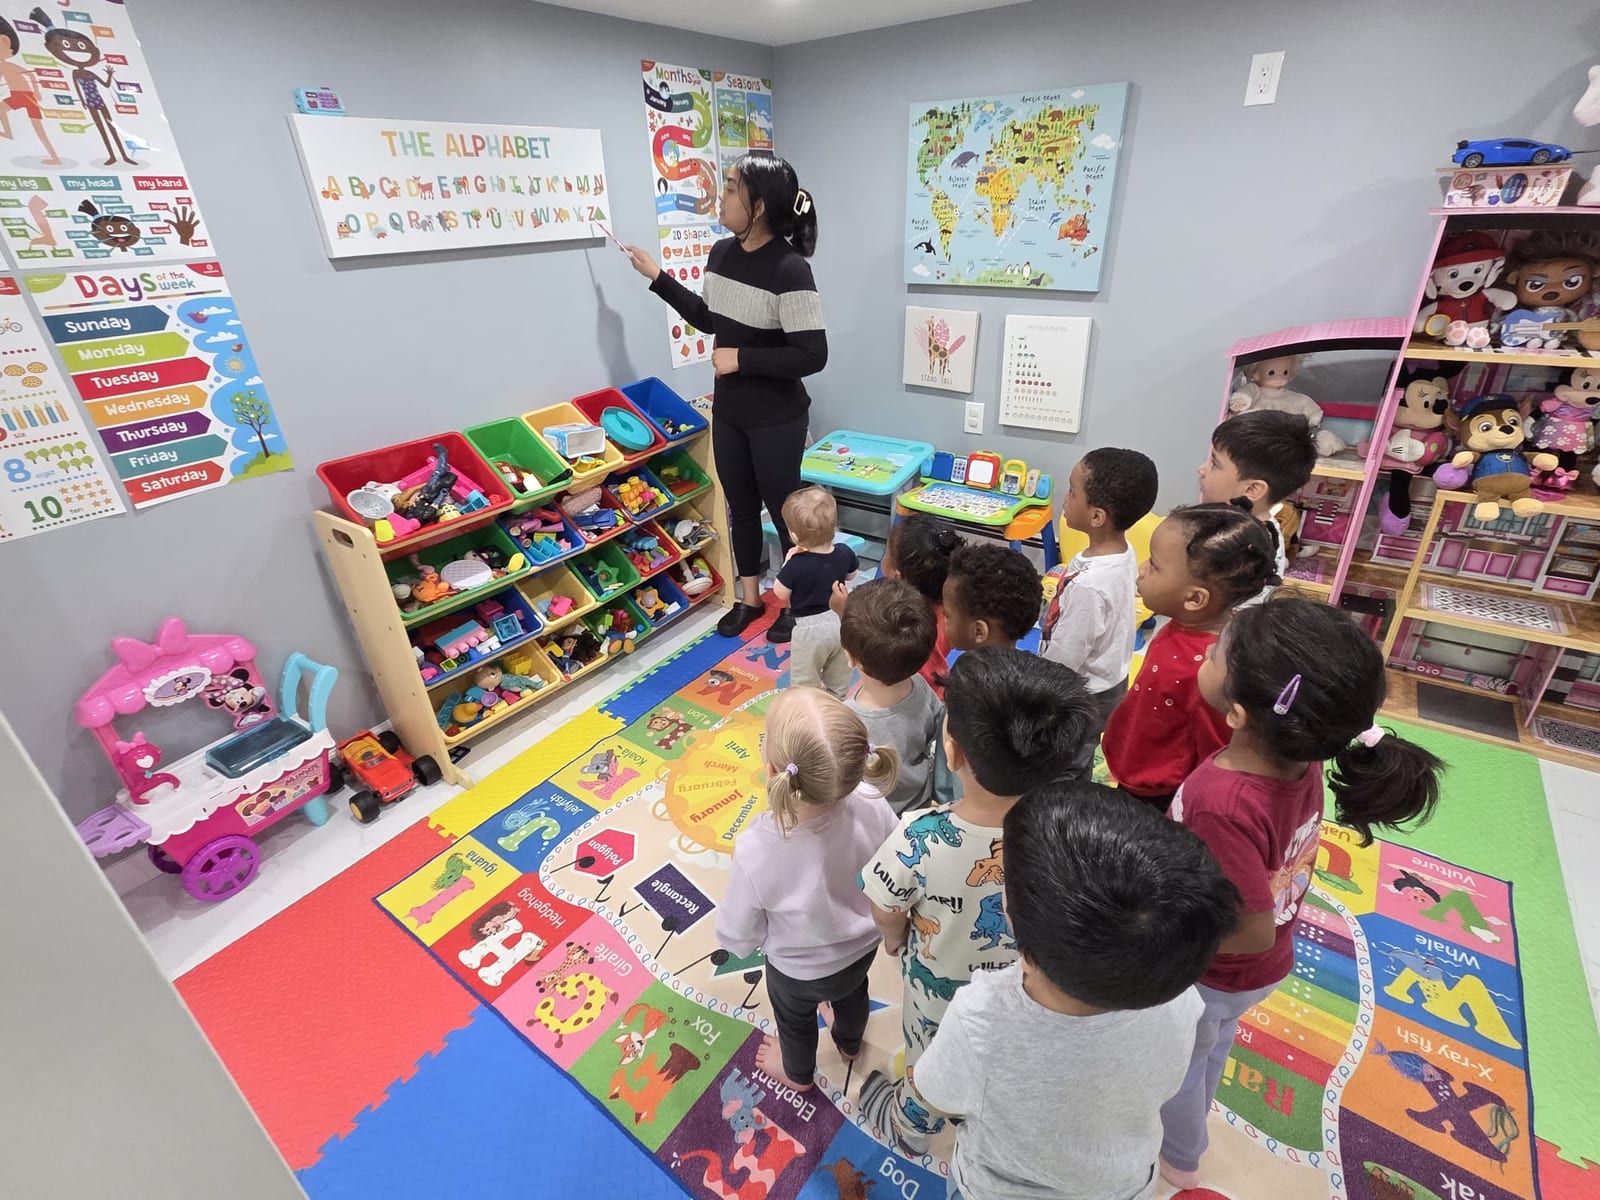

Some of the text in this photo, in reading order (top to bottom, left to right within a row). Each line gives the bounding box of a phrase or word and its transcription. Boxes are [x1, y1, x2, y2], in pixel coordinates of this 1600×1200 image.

[656, 65, 692, 85] Months
[727, 75, 761, 91] Seasons
[381, 130, 551, 159] THE ALPHABET
[1083, 165, 1105, 173] Pacific
[17, 178, 39, 190] leg
[66, 178, 115, 190] my head
[138, 178, 183, 190] my hand
[327, 176, 344, 196] A
[348, 176, 364, 197] B
[379, 177, 396, 199] C
[406, 178, 420, 198] D
[437, 176, 449, 197] E
[474, 176, 486, 193] G
[490, 175, 504, 192] H
[509, 176, 520, 193] I
[531, 177, 541, 193] J
[546, 176, 557, 193] K
[576, 175, 590, 193] M
[594, 174, 604, 194] N
[345, 206, 595, 233] O P Q R S T U V W X Y Z
[673, 228, 711, 240] 2D Shapes
[73, 272, 157, 302] Days
[156, 271, 186, 281] of the
[158, 278, 197, 291] week
[64, 316, 132, 334] Sunday
[77, 342, 146, 361] Monday
[90, 369, 160, 389] Tuesday
[104, 392, 192, 417] Wednesday
[116, 421, 188, 443] Thursday
[3, 458, 32, 483] 8
[128, 450, 178, 468] Friday
[141, 470, 208, 493] Saturday
[24, 496, 63, 524] 10
[729, 666, 760, 682] Marmot
[687, 708, 708, 722] Lion
[622, 748, 648, 767] Koala
[724, 740, 751, 760] April
[704, 760, 739, 773] March
[678, 778, 737, 793] February
[550, 793, 584, 816] Jellyfish
[690, 789, 744, 823] January
[722, 795, 758, 841] December
[465, 850, 498, 877] Iguana
[588, 839, 624, 867] Polygon
[1411, 856, 1476, 888] Vulture
[517, 887, 567, 929] Hedgehog
[651, 879, 700, 915] Rectangle
[594, 943, 633, 977] Giraffe
[1415, 933, 1481, 970] Whale
[690, 1015, 721, 1047] Fox
[1396, 1026, 1494, 1082] X-ray fish
[751, 1069, 817, 1122] Elephant
[878, 1156, 921, 1200] Dog
[1439, 1171, 1486, 1200] ak
